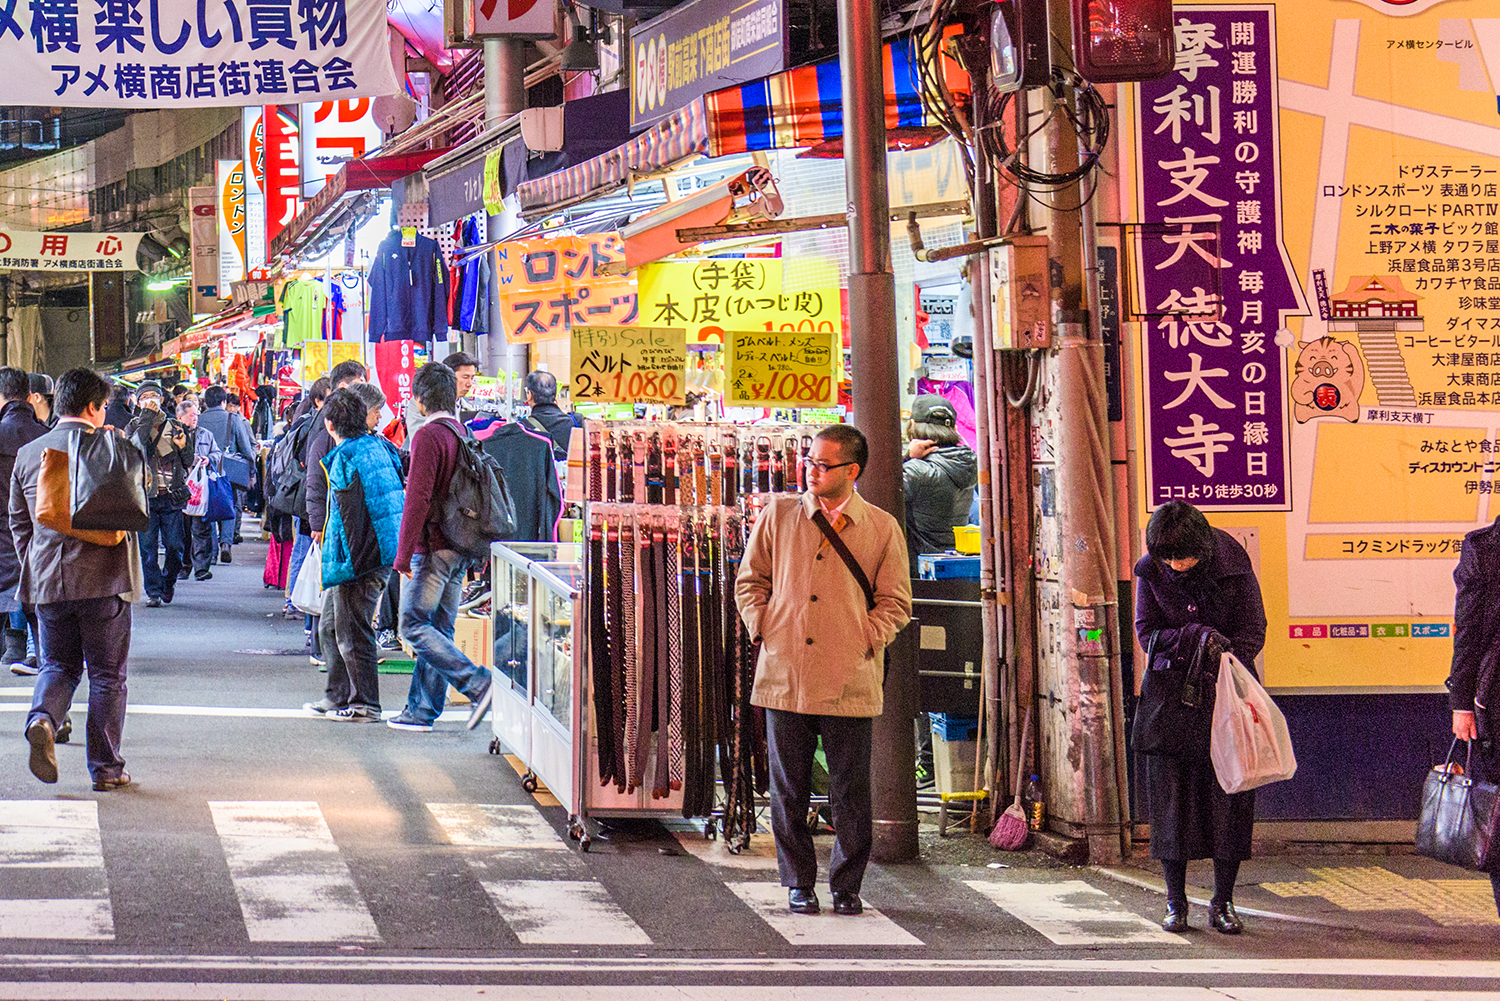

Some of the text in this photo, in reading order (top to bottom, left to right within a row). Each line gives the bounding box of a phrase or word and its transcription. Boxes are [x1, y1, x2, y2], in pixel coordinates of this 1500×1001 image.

[1386, 39, 1473, 50] アメ横センタービル
[51, 56, 357, 99] アメ横商店街連合会
[1399, 165, 1497, 178] ドヴステーラー
[1323, 183, 1497, 198] ロンドンスポーツ 表通り店
[230, 172, 245, 235] ロンドン
[1355, 204, 1438, 217] シルクロード
[1152, 17, 1236, 478] 摩利支天徳大寺
[1231, 21, 1269, 476] 開運勝利の守護神 毎月亥の日縁日
[1365, 240, 1500, 255] 上野アメ横 タワラ屋
[43, 257, 124, 269] アメ横商店街連合会
[523, 236, 640, 286] ロンド
[1387, 258, 1500, 273] 浜屋食品第3号店
[1415, 277, 1500, 291] カワチヤ食品
[1458, 296, 1500, 311] 珍味堂
[512, 287, 639, 336] スポーツ
[1446, 317, 1500, 331] ダイマス
[620, 329, 669, 348] Sale
[580, 350, 632, 374] ベルト
[575, 373, 606, 398] 2本
[1367, 409, 1435, 424] 摩利支天横丁
[1159, 484, 1278, 499] ココより徒歩30秒
[1413, 627, 1448, 636] スポーツ
